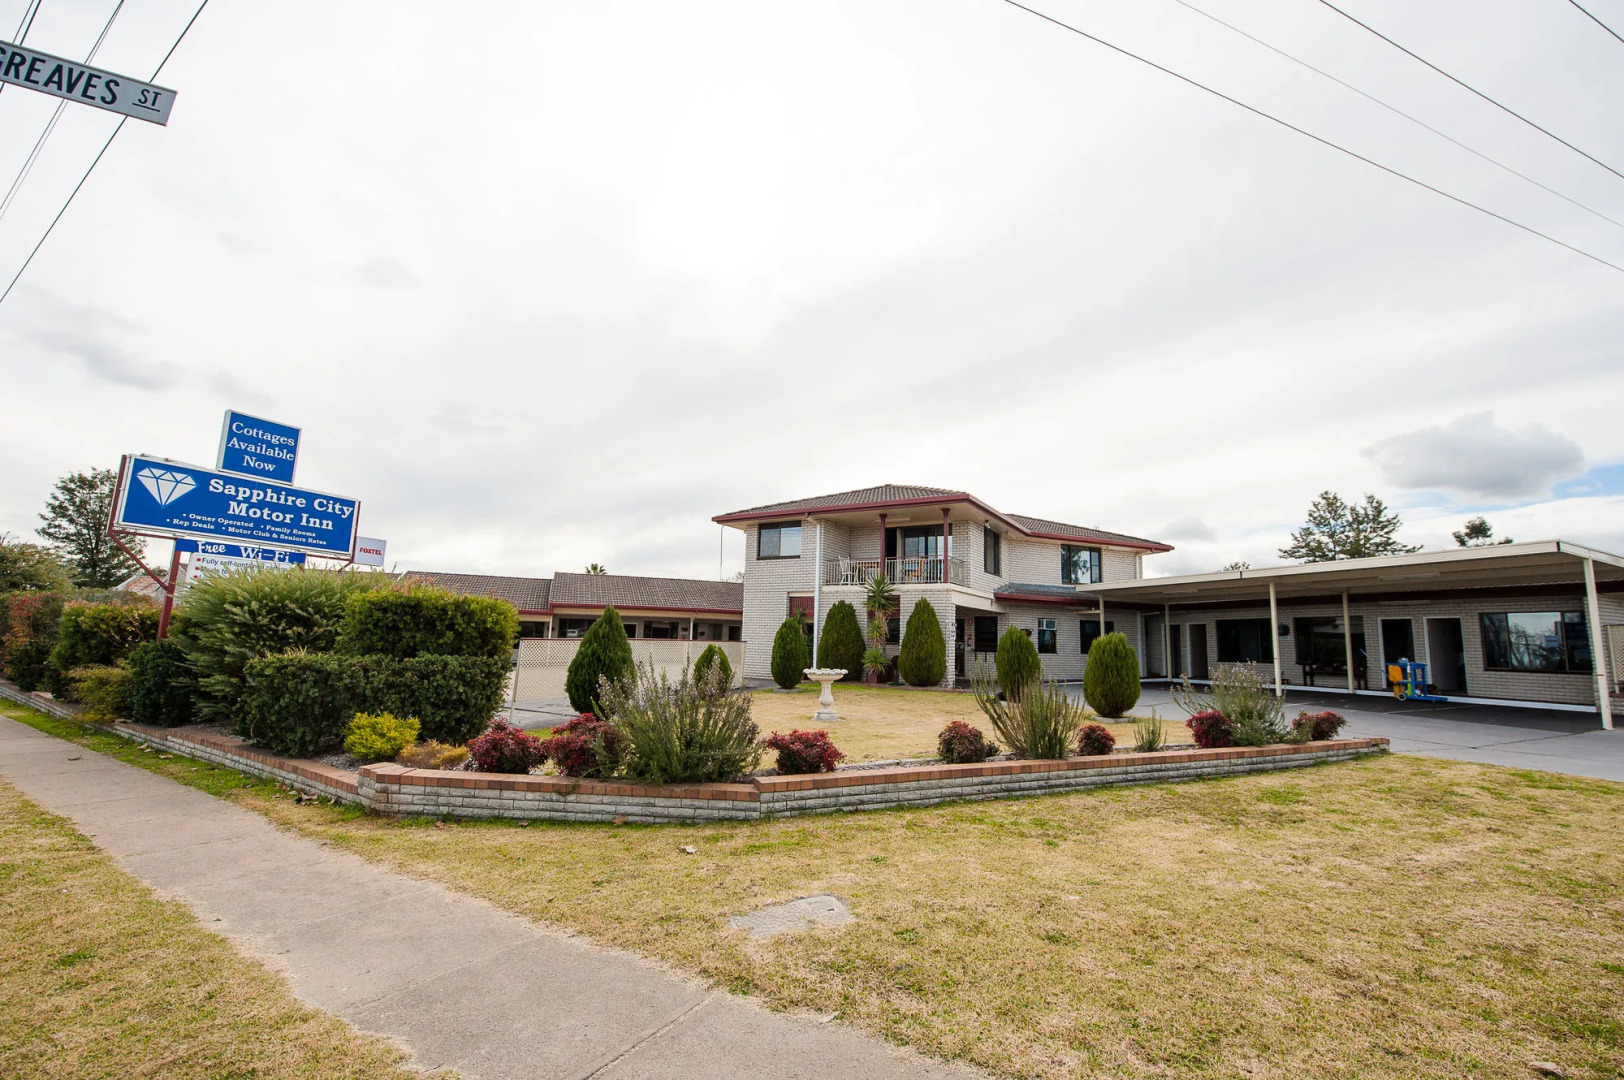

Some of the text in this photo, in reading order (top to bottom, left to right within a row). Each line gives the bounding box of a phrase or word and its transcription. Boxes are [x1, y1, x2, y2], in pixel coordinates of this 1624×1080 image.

[137, 88, 162, 107] ST
[231, 422, 295, 446] Cottages
[227, 437, 295, 461] Available
[243, 455, 276, 472] Now
[209, 479, 354, 518] Sapphire City
[172, 518, 215, 530] Rep Deals
[189, 513, 254, 528] Owner Operated
[227, 501, 334, 530] Motor Inn
[228, 527, 251, 535] Motor
[253, 530, 270, 538] Club
[279, 533, 306, 543] Seniors
[307, 537, 327, 545] Rates
[266, 525, 316, 537] Family Rooms
[197, 541, 290, 563] Free Wi-Fi
[359, 547, 382, 556] FOXTEL
[202, 557, 219, 566] Fully
